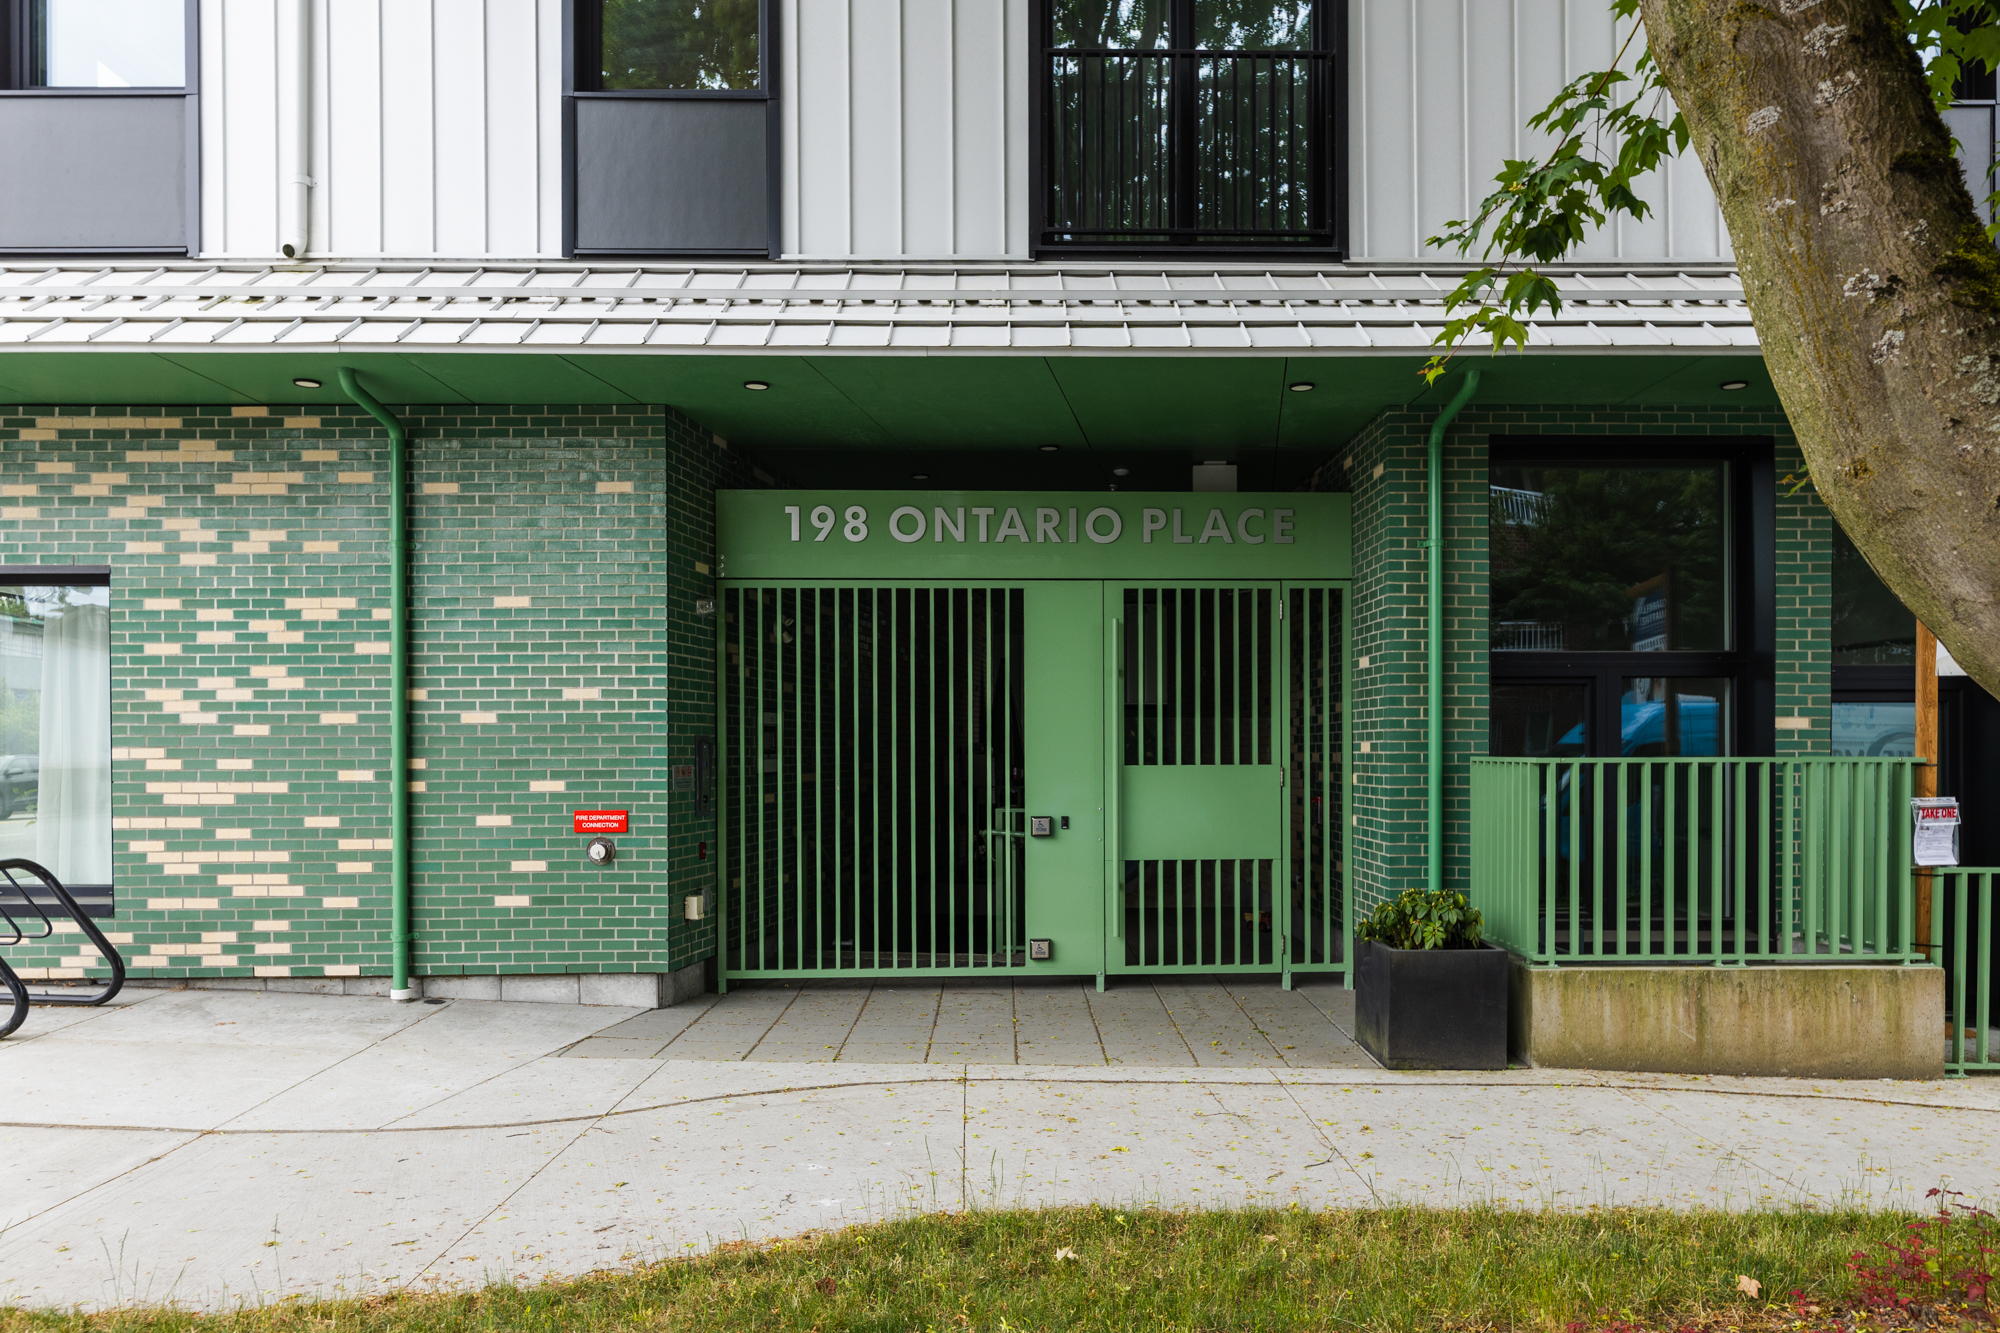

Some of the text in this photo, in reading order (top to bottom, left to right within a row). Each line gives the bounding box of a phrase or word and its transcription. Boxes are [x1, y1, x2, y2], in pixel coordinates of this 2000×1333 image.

[784, 505, 1296, 545] 198 ONTARIO PLACE
[1921, 806, 1957, 819] TAKE ONE
